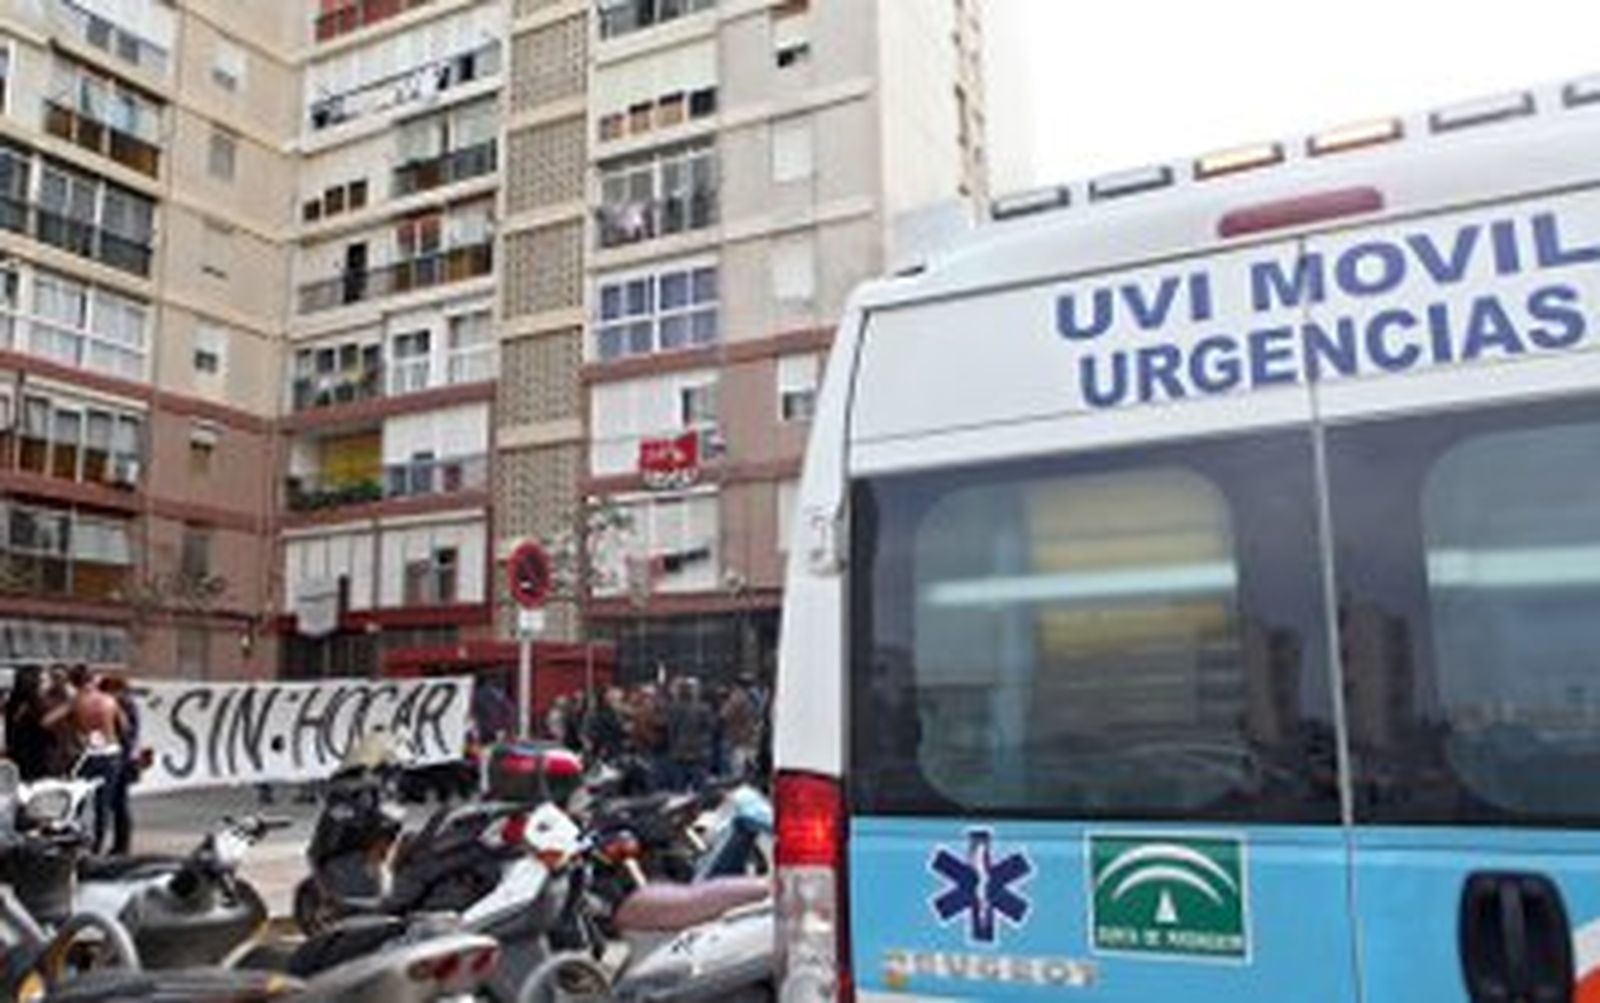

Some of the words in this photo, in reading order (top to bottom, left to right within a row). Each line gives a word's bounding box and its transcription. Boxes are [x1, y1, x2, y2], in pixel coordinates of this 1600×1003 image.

[1055, 270, 1211, 341] UVI
[1249, 211, 1600, 312] MOVIL
[1078, 284, 1587, 409] URGENCIAS
